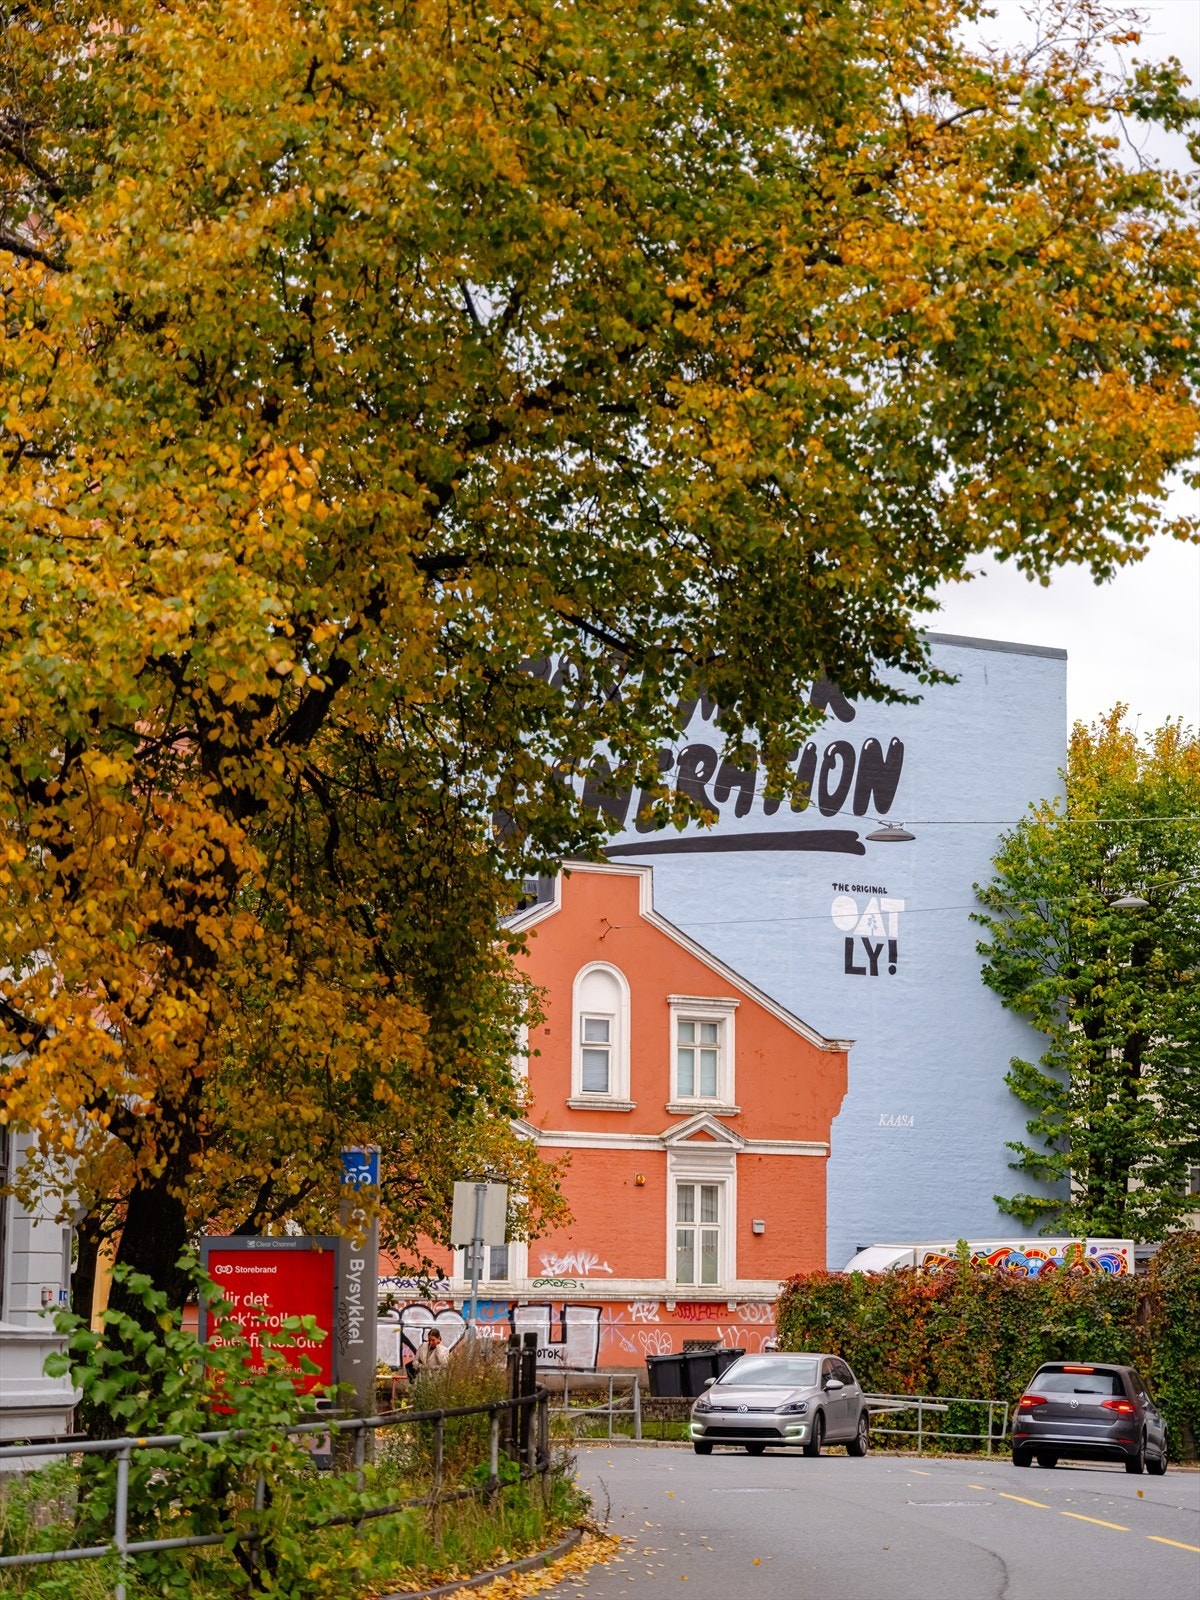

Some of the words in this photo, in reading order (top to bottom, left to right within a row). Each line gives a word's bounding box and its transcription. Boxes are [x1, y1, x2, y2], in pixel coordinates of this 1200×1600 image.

[831, 882, 850, 892] THE
[852, 884, 888, 895] ORIGINAL
[831, 895, 905, 937] OAT
[844, 937, 898, 977] LY!
[255, 1240, 271, 1248] Clear
[272, 1240, 297, 1248] Channel
[235, 1265, 277, 1274] Storebrand
[218, 1291, 241, 1306] lir
[243, 1291, 270, 1307] det
[345, 1259, 365, 1345] Bysykkel
